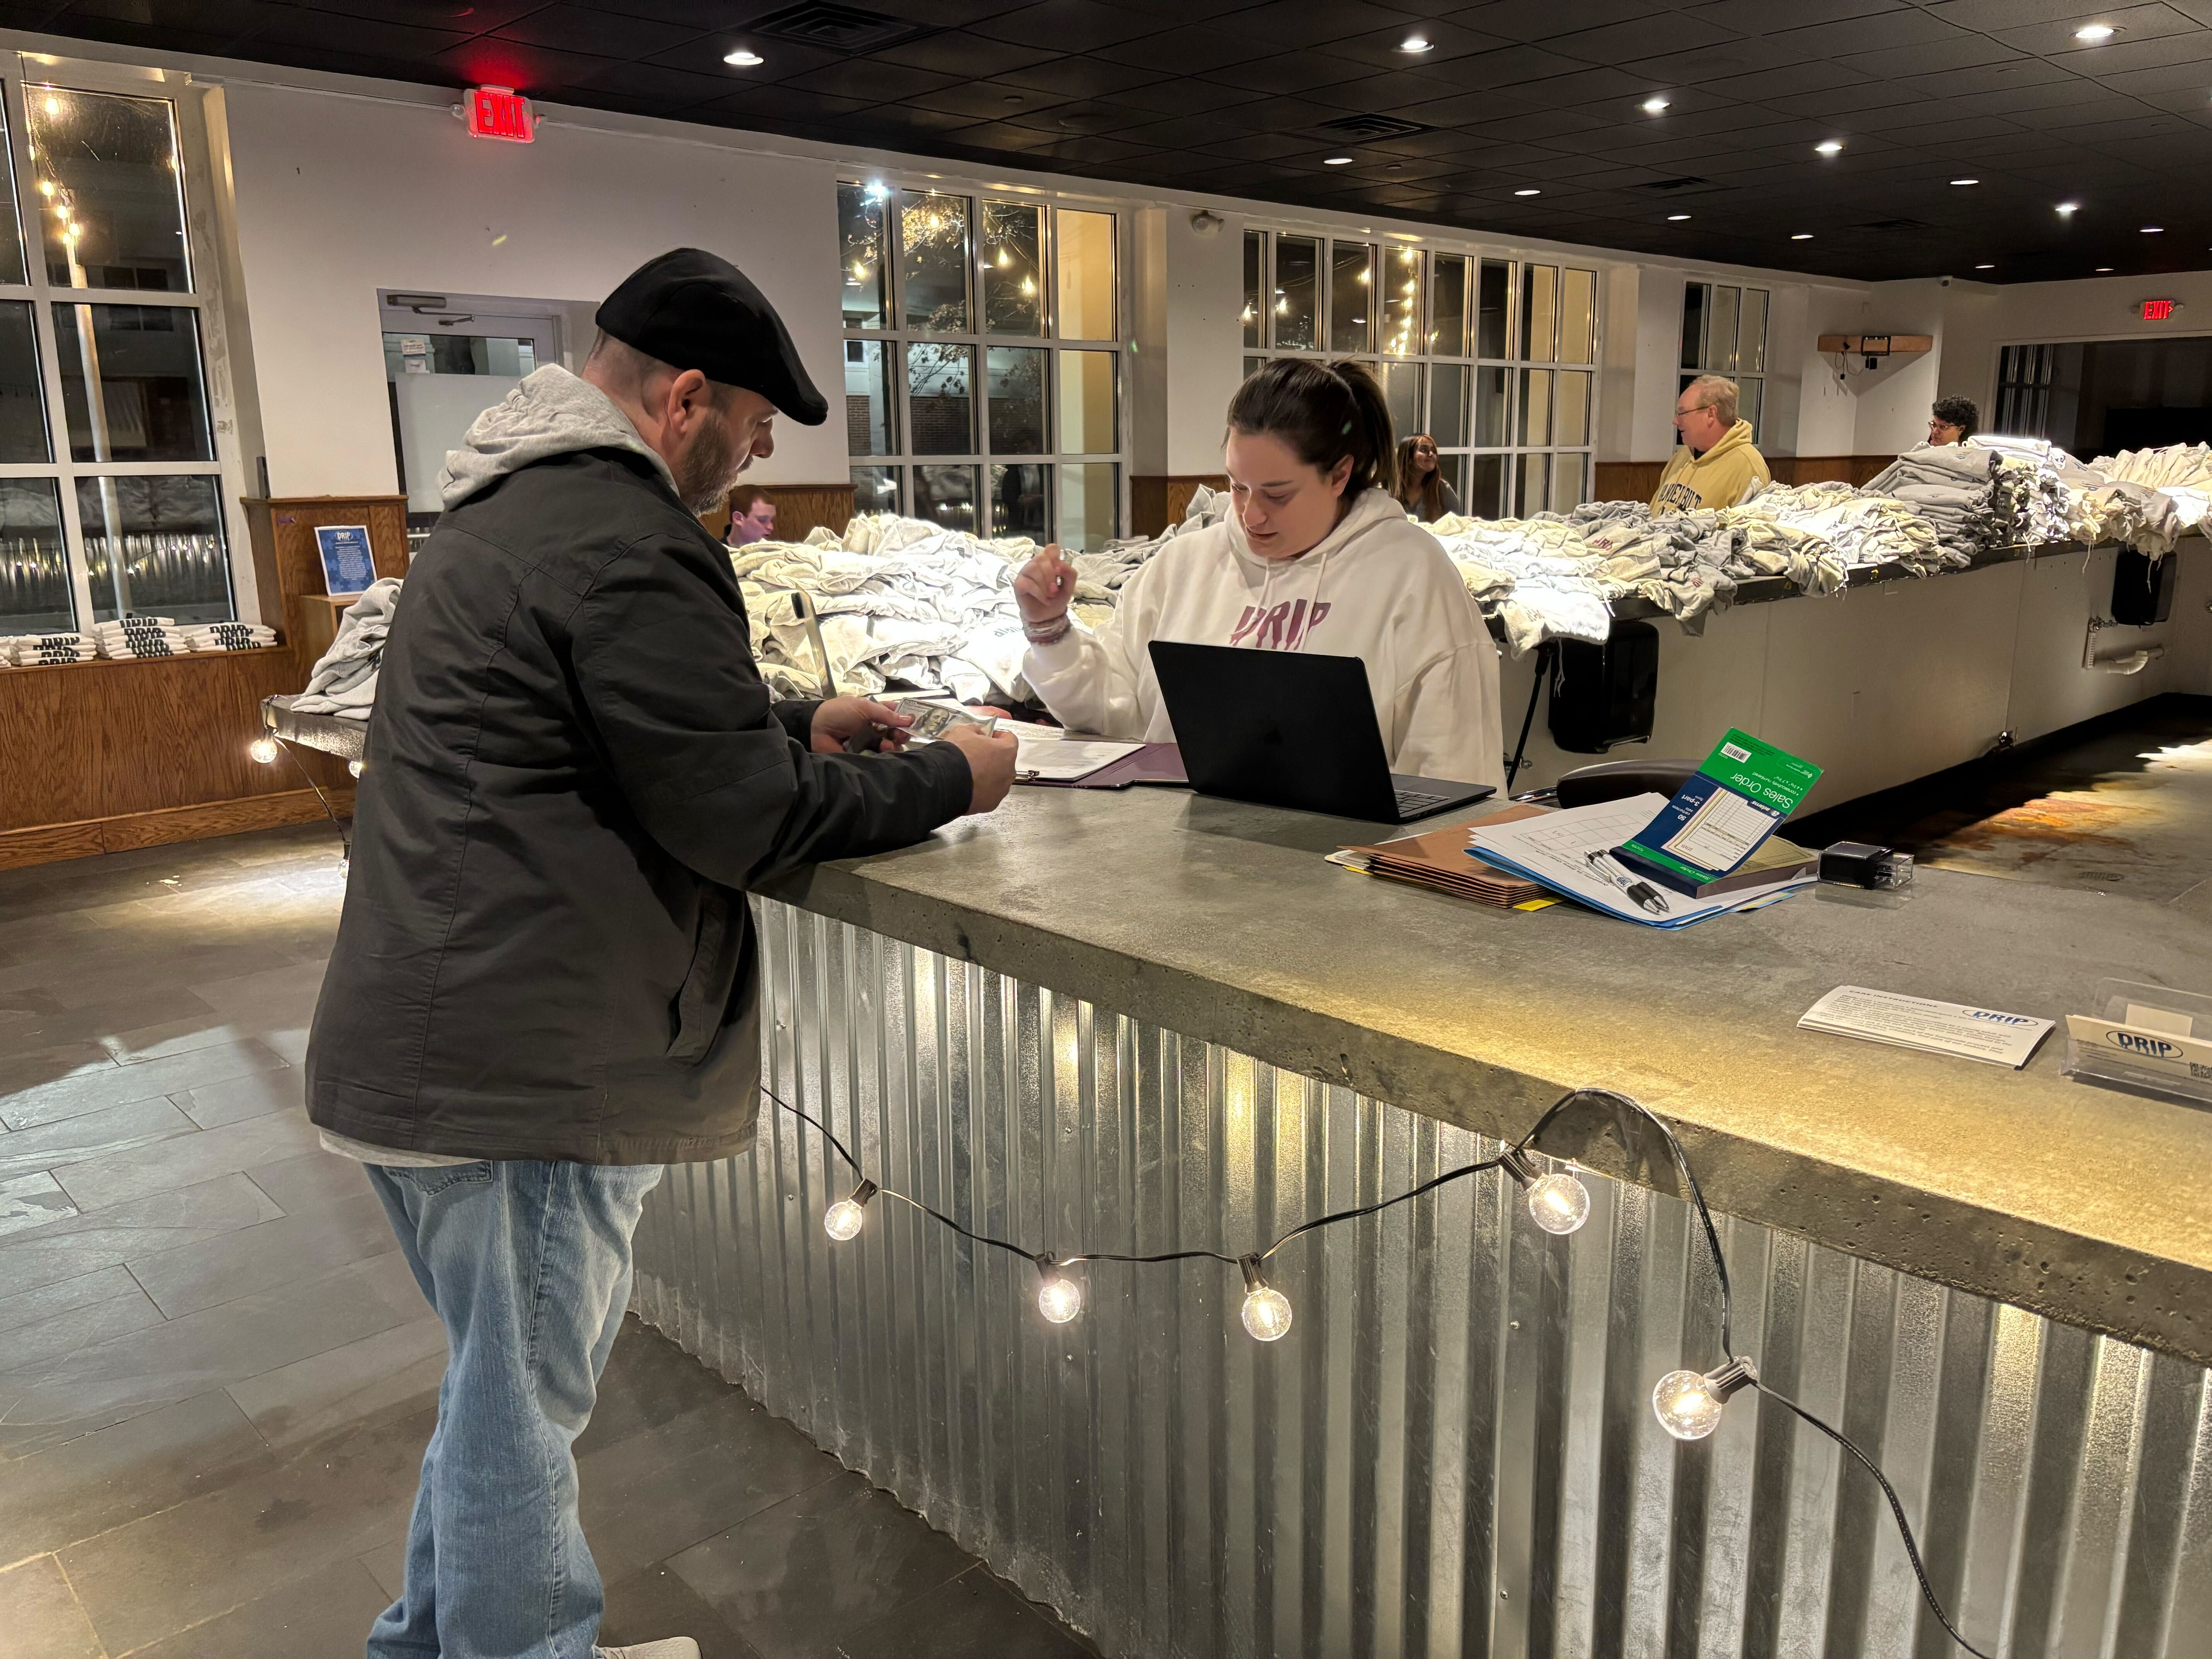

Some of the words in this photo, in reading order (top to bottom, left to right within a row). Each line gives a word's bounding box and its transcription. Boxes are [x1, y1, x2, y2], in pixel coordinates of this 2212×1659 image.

[475, 91, 525, 138] EXIT
[2143, 301, 2171, 319] EXIT
[337, 532, 350, 541] DRIP
[1229, 599, 1331, 651] DRIP
[41, 637, 80, 646] DRIP
[1730, 772, 1760, 792] Order
[1752, 772, 1772, 783] numbered
[1771, 781, 1796, 795] consecutively
[1681, 794, 1700, 806] 3-part
[1762, 787, 1794, 809] Sales
[1672, 805, 1690, 816] carbonless
[1751, 800, 1771, 812] adams
[1679, 865, 1695, 875] Order
[1696, 871, 1710, 881] Sales
[1874, 994, 1938, 1008] INSTRUCTIONS
[1973, 1011, 2028, 1025] DRIP
[2118, 1033, 2172, 1057] DRIP
